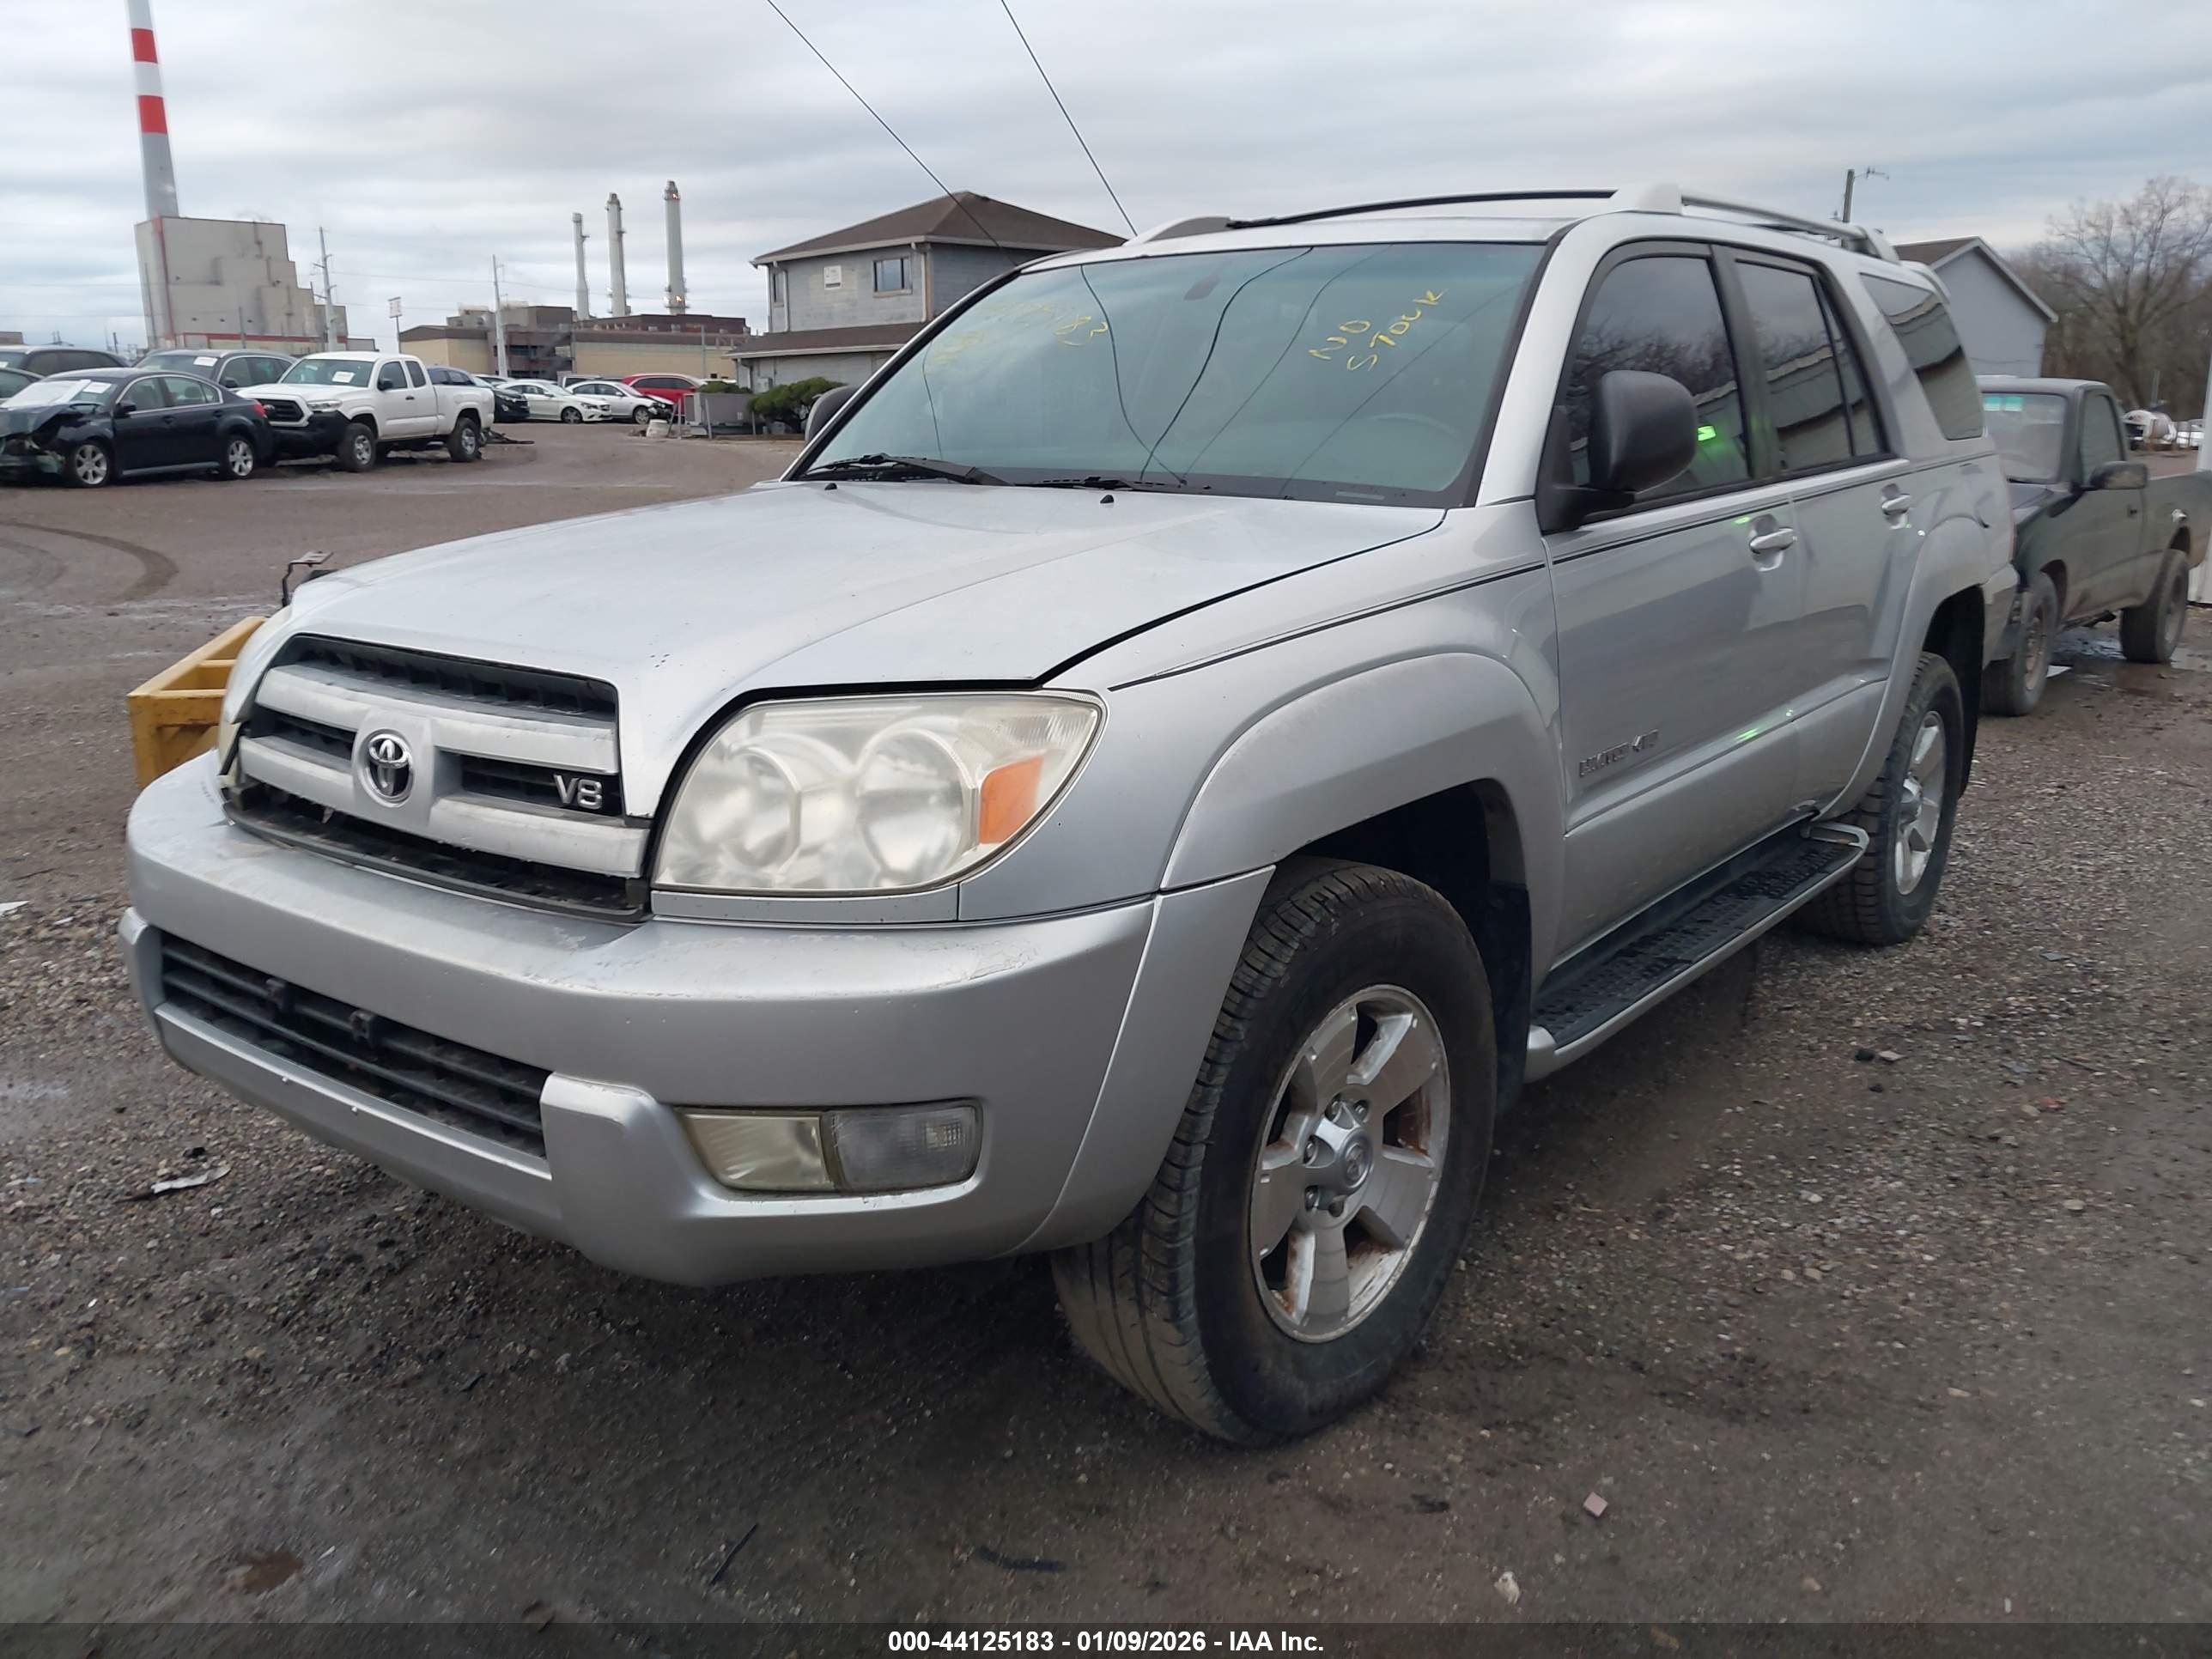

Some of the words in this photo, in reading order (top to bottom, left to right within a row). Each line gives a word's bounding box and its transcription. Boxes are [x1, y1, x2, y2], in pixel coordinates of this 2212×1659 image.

[1309, 319, 1371, 361] NO
[1346, 288, 1449, 372] STOCK
[553, 774, 602, 810] V8
